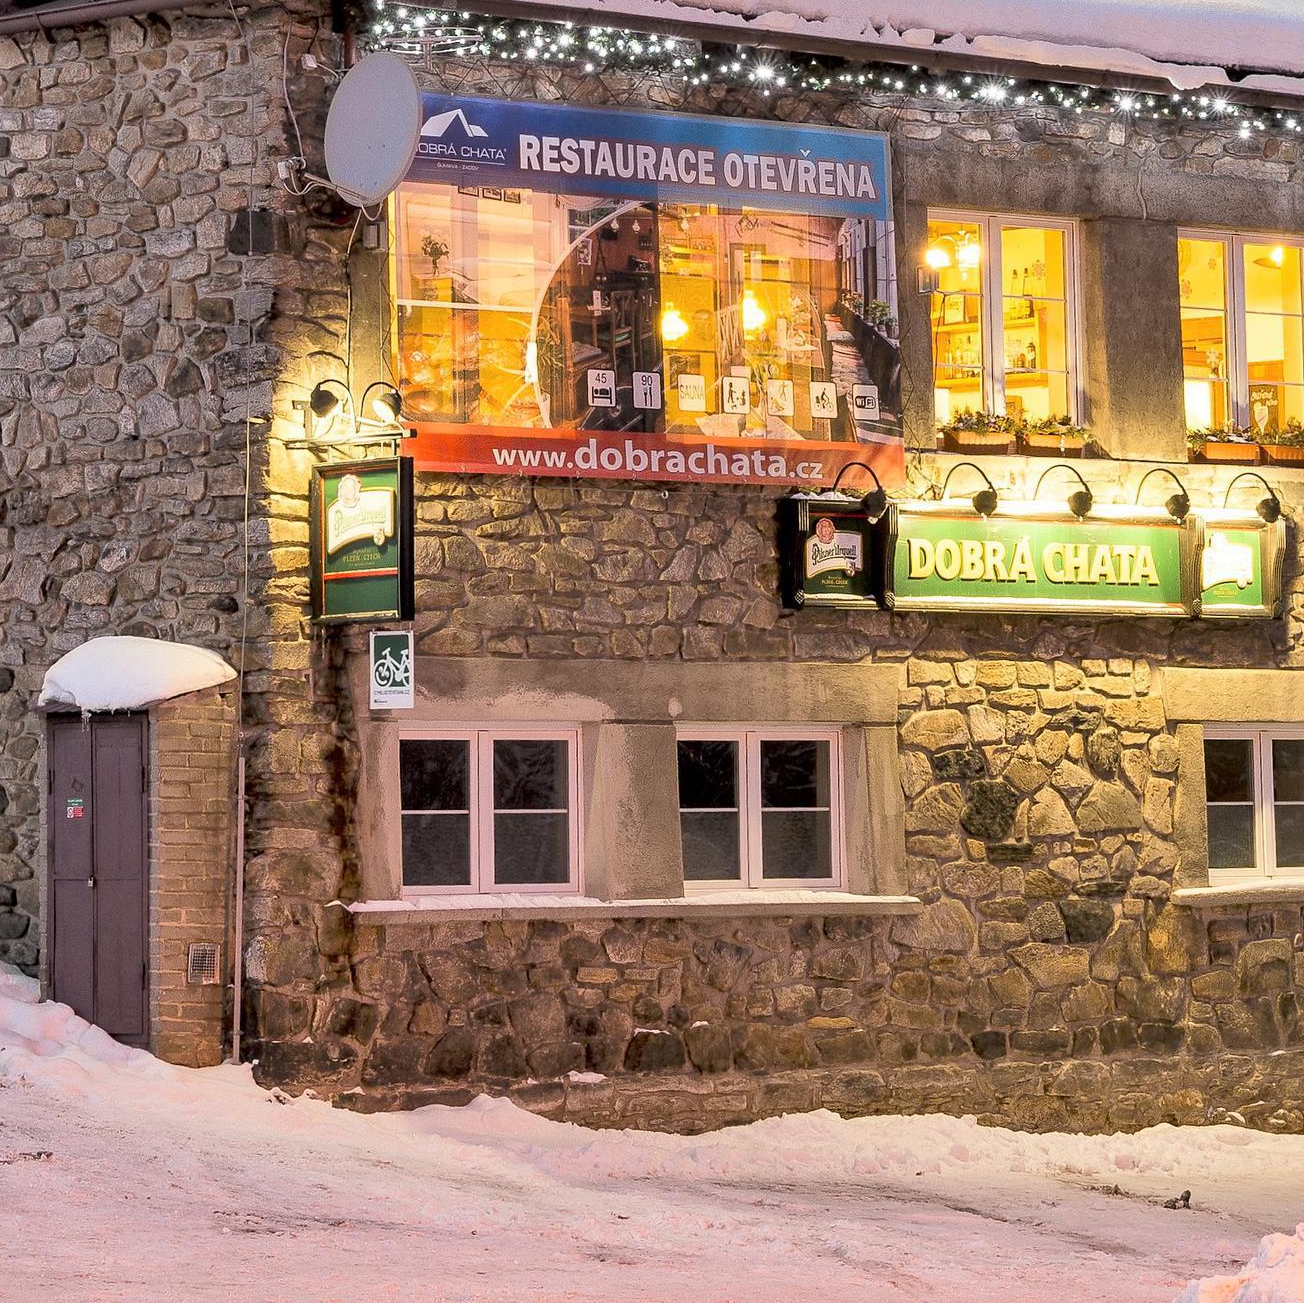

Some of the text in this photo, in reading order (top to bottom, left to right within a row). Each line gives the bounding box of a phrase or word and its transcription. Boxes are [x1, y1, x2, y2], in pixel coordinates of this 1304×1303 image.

[418, 142, 457, 156] OBRÁ
[519, 133, 877, 199] RESTAURACE OTEVŘENA
[596, 372, 607, 384] 45
[641, 375, 653, 386] 90
[679, 384, 705, 400] SAUNA
[493, 438, 823, 480] www.dobrachata.cz
[811, 542, 857, 566] Pilsner Urquell
[907, 534, 1160, 587] DOBRÁ CHATA
